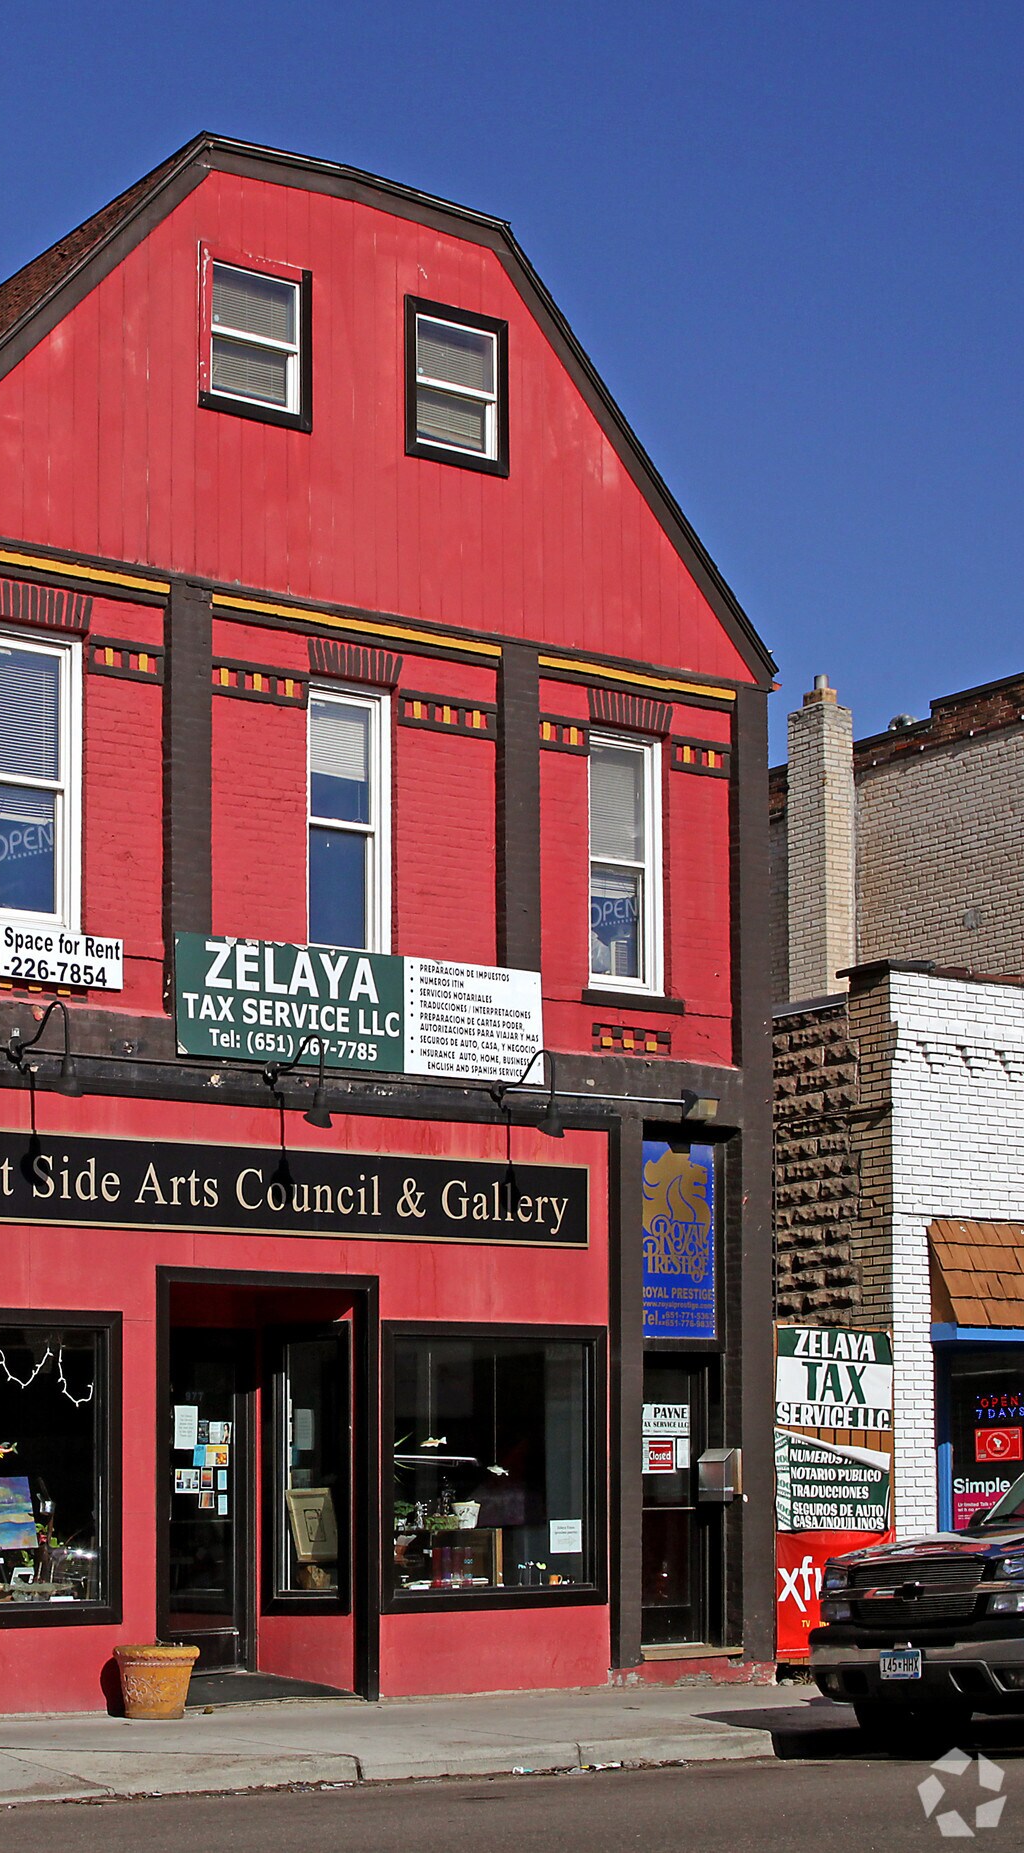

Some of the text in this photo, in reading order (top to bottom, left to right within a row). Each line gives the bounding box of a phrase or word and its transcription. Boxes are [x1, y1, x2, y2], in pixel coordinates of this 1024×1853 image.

[591, 897, 637, 928] OPEN
[5, 927, 53, 953] Space
[59, 933, 79, 955] for
[85, 937, 120, 960] Rent
[205, 940, 379, 1004] ZELAYA
[420, 964, 509, 982] PREPARACION DE IMPUESTOS
[420, 976, 464, 988] NUMEROS ITIN
[420, 988, 492, 1003] SERVICIOS NOTARIALES
[182, 992, 400, 1037] TAX SERVICE LLC
[420, 1000, 467, 1012] TRADUCCIONES
[472, 1006, 531, 1019] INTERPRETACIONES
[420, 1012, 465, 1025] PREPARACION
[467, 1017, 475, 1026] DE
[477, 1018, 500, 1027] CARTAS
[420, 1023, 475, 1036] AUTORIZACIONES
[477, 1029, 494, 1038] PARA
[496, 1031, 518, 1040] VIAJAR
[526, 1034, 538, 1042] MAS
[209, 1028, 240, 1048] Tel:
[247, 1031, 294, 1057] (651)
[420, 1035, 536, 1054] SEGUROS DE AUTO, CASA, Y NEGOCIO
[420, 1048, 455, 1059] INSURANCE
[459, 1052, 478, 1063] AUTO,
[480, 1054, 500, 1065] HOME,
[428, 1062, 453, 1071] ENGLISH
[456, 1064, 469, 1073] AND
[471, 1065, 497, 1075] SPANISH
[33, 1154, 121, 1202] Side
[134, 1162, 219, 1208] Arts
[236, 1168, 382, 1216] Council
[396, 1177, 426, 1218] &
[441, 1180, 569, 1235] Gallery
[650, 1214, 708, 1256] ROYAL
[671, 1287, 713, 1300] PRESTIGE
[794, 1329, 876, 1361] ZELAYA
[802, 1361, 866, 1405] TAX
[980, 1396, 1019, 1408] OPEN
[654, 1406, 687, 1419] PAYNE
[777, 1402, 890, 1429] SERVICE LLC
[976, 1406, 1024, 1419] 7 DAYS
[649, 1450, 671, 1460] Closed
[791, 1466, 882, 1482] NOTARIO PUBLICO
[791, 1483, 869, 1499] TRADUCCIONES
[954, 1477, 1010, 1496] Simple
[793, 1502, 884, 1517] SEGUROS DE AUTO
[801, 1620, 810, 1628] TV
